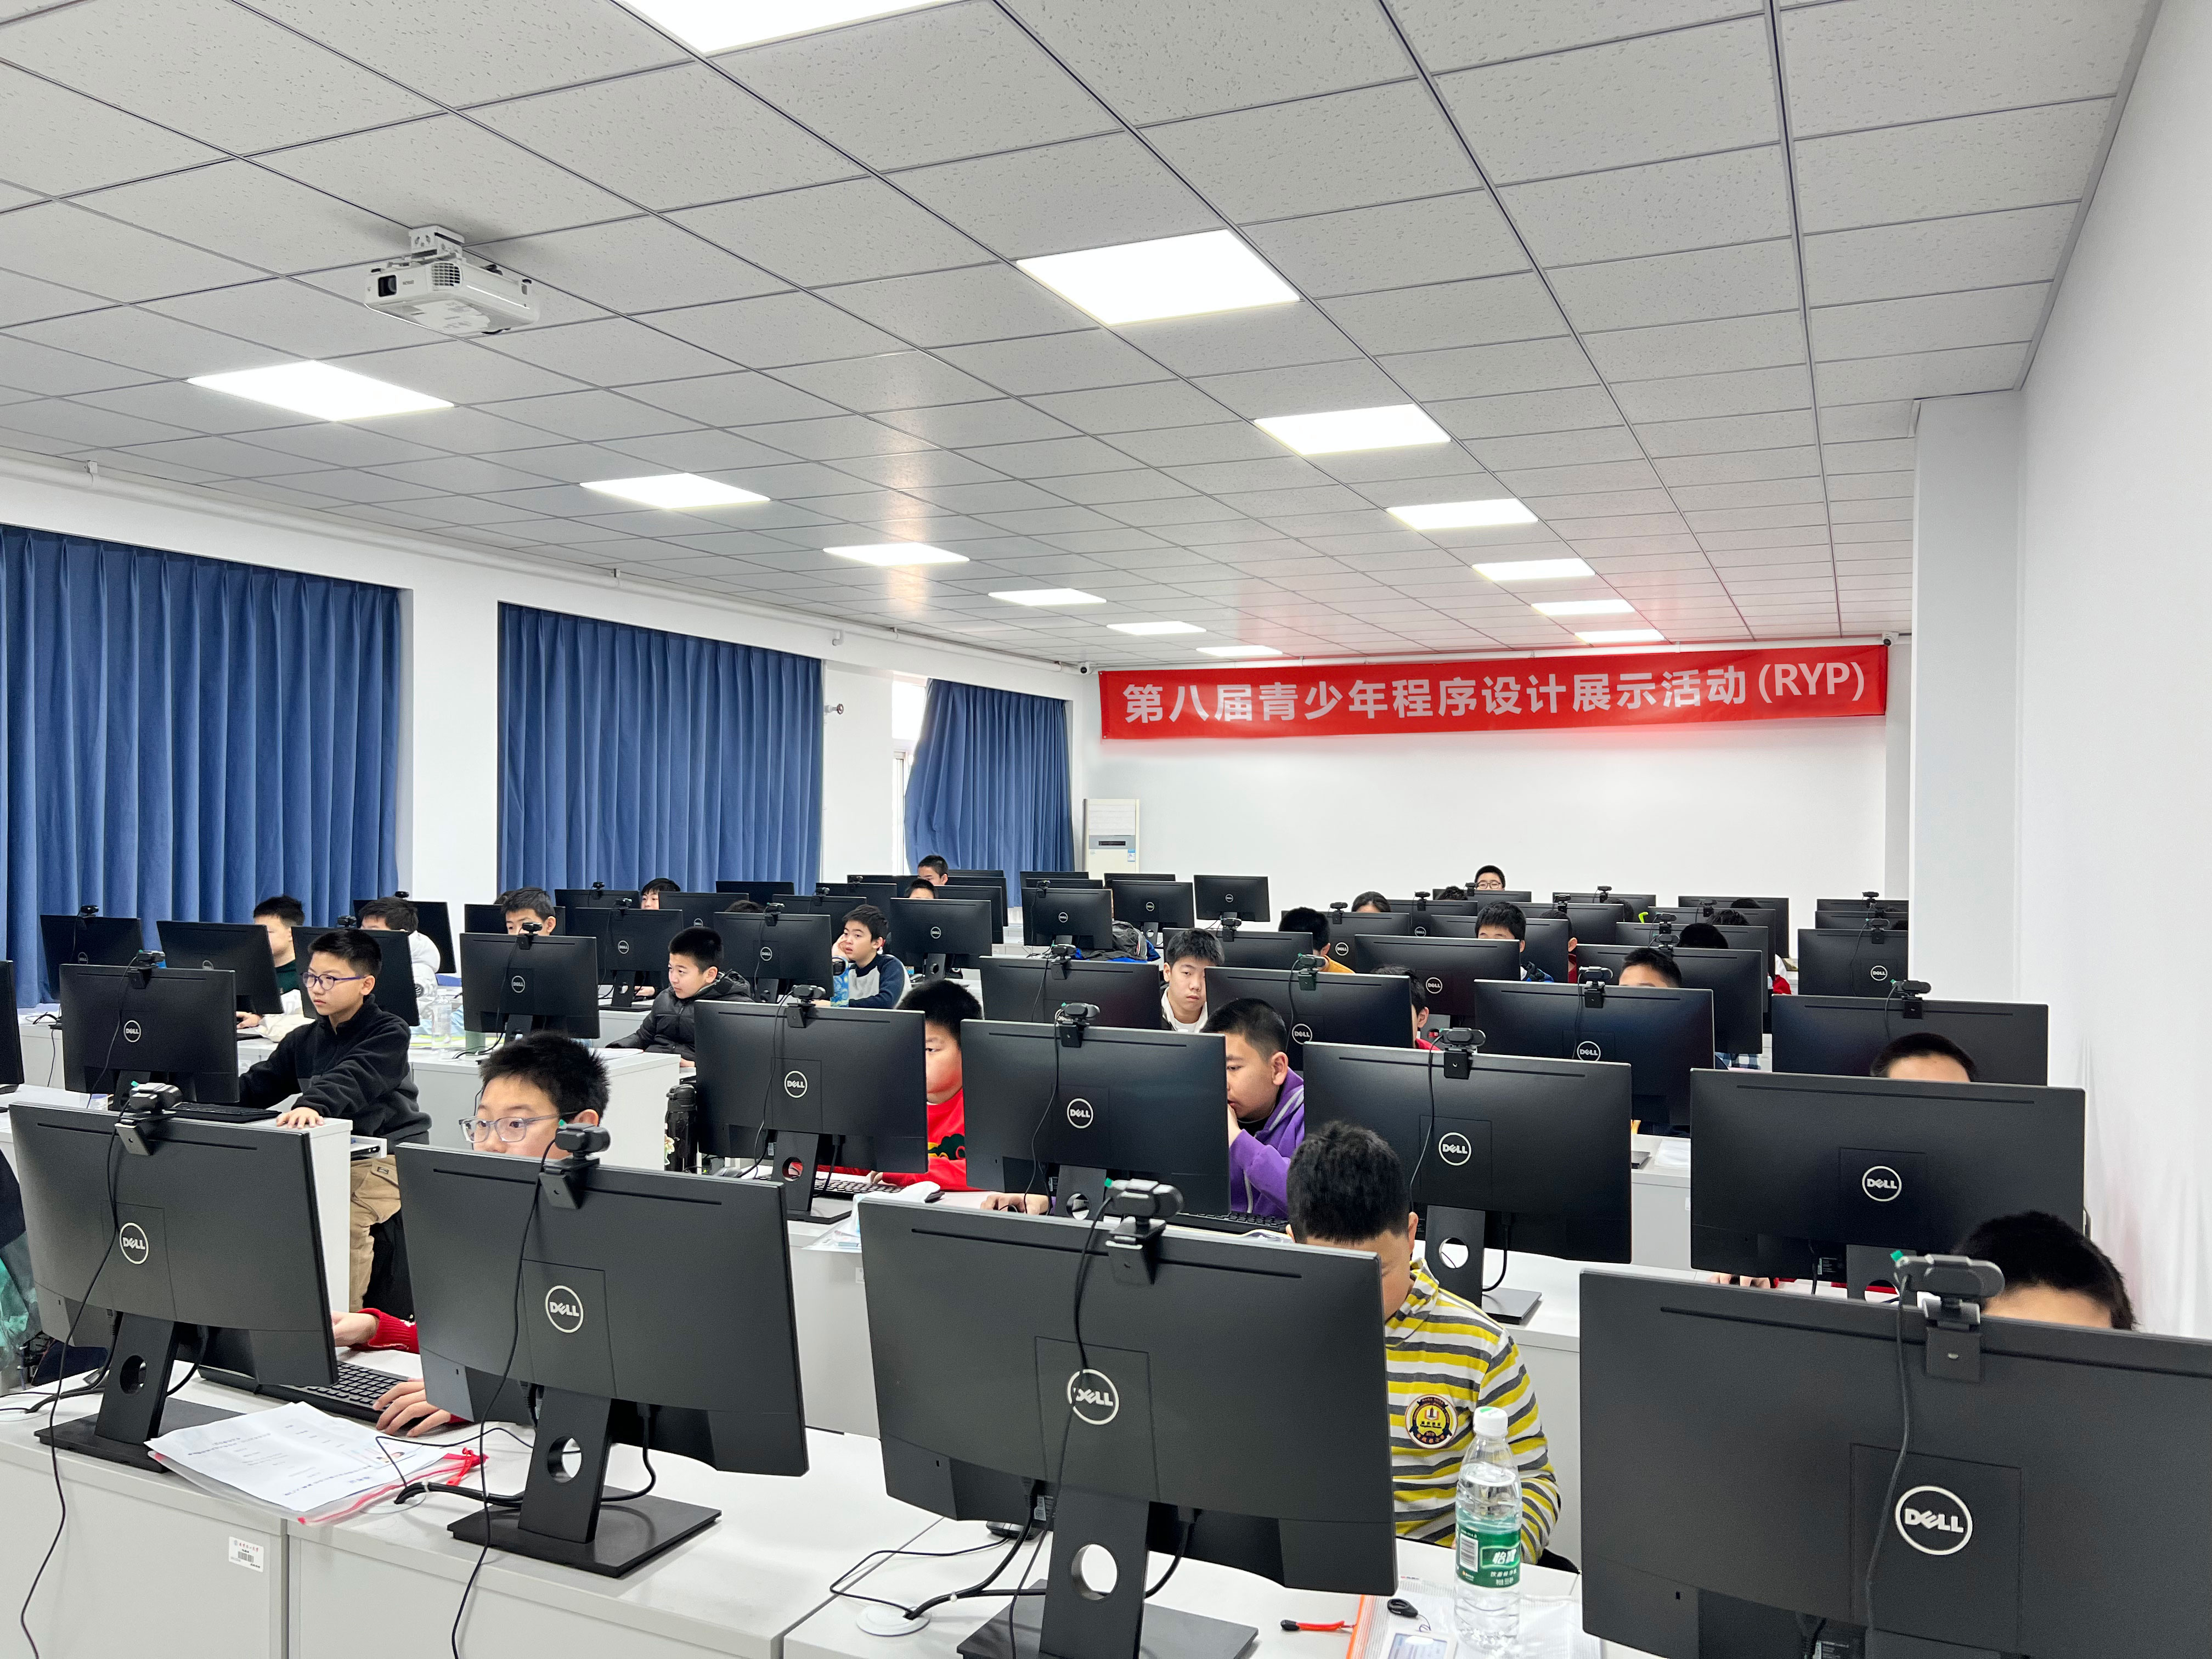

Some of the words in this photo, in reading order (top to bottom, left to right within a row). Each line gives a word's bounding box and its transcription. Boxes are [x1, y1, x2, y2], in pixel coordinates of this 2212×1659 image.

[787, 1080, 805, 1088] DELL
[1070, 1109, 1091, 1118] DELL
[1442, 1143, 1468, 1154] DELL
[1867, 1178, 1897, 1189] DELL
[122, 1237, 146, 1250] DELL
[550, 1301, 580, 1317] DELL
[1904, 1507, 1965, 1534] DELL
